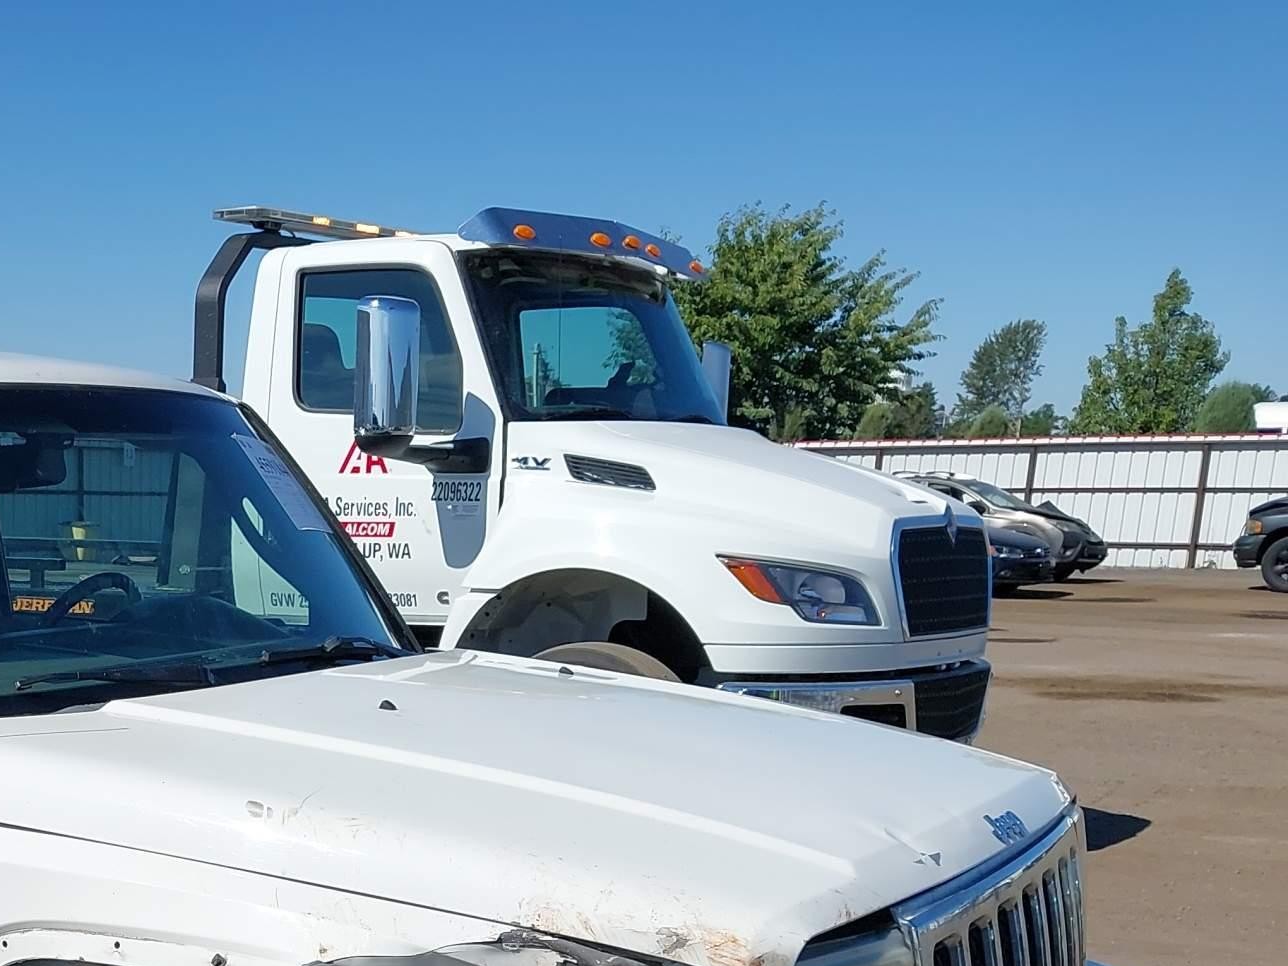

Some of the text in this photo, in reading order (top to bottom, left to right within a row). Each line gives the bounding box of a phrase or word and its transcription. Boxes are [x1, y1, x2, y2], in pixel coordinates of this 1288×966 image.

[431, 481, 482, 501] 22096322
[334, 496, 392, 519] Services,
[395, 496, 417, 517] Inc.
[344, 523, 391, 536] AI.COM
[361, 543, 412, 561] UP, WA
[270, 592, 296, 608] GVW
[983, 811, 1027, 846] Jeep
